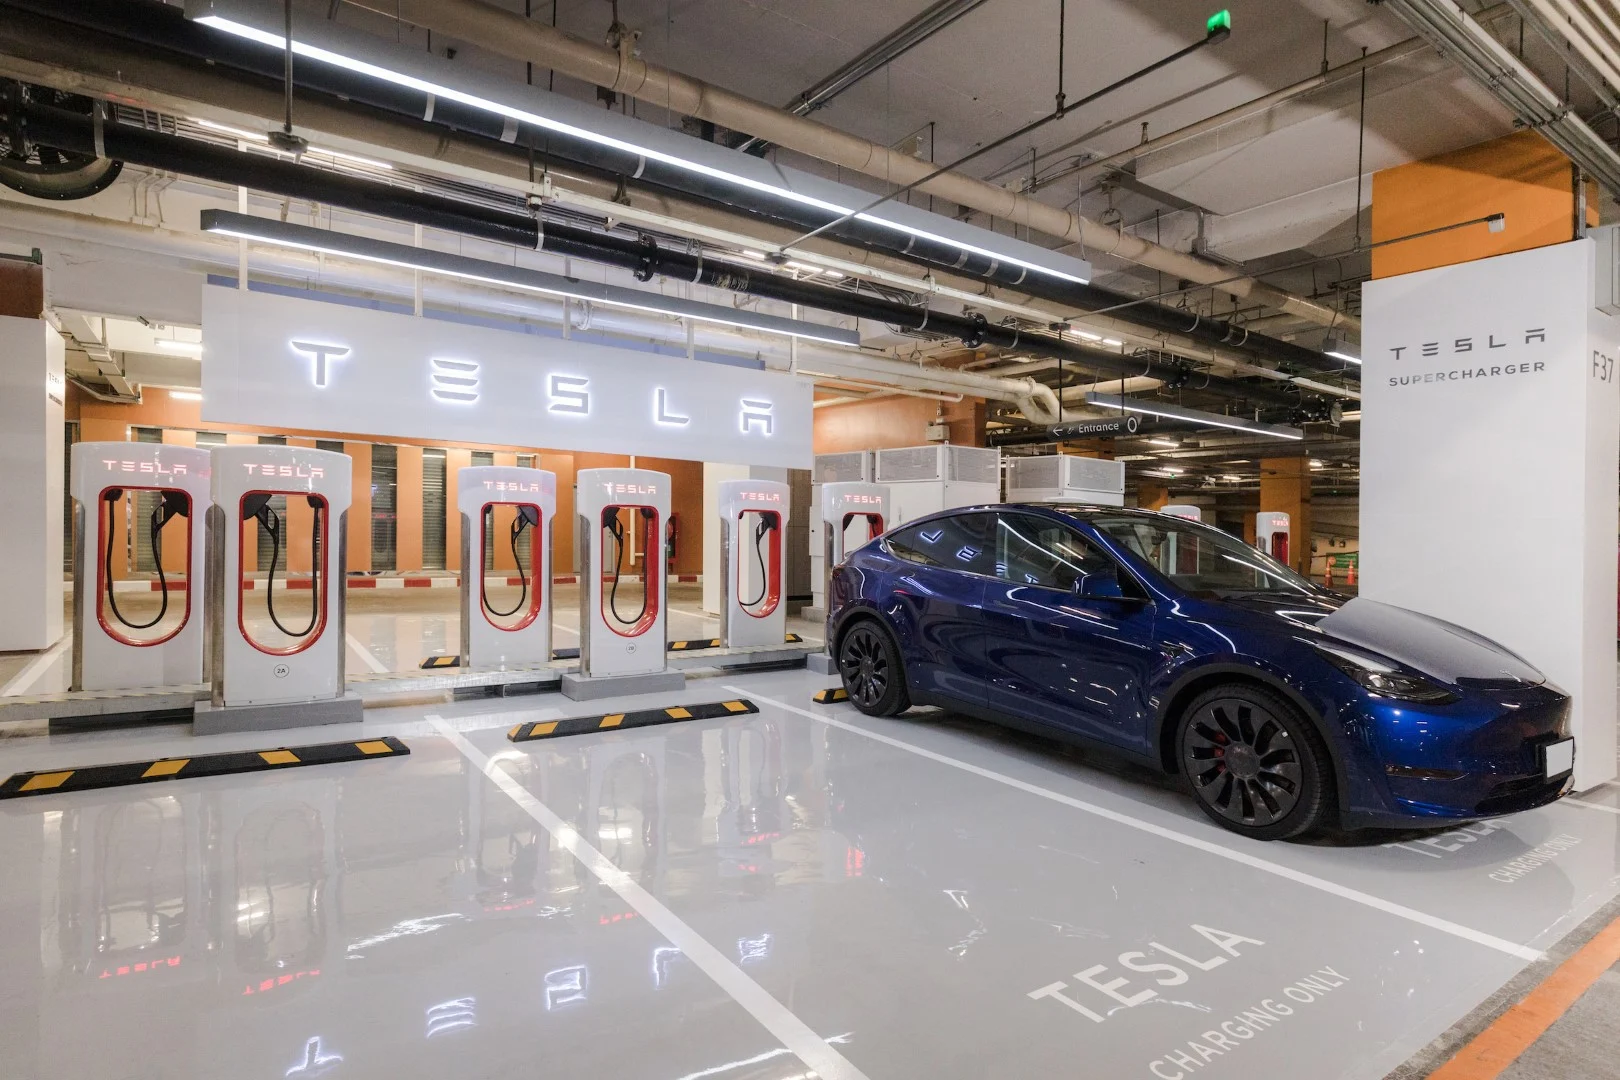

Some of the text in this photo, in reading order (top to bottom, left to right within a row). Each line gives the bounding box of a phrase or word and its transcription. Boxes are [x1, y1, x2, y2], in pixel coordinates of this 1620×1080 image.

[1389, 328, 1545, 360] TESLA
[1389, 361, 1545, 386] SUPERCHARGER
[1593, 350, 1614, 383] F37
[290, 340, 774, 435] TESLA
[1078, 422, 1120, 433] Entrance
[103, 459, 187, 474] TESLA
[243, 463, 324, 478] TESLA
[483, 481, 539, 492] TESLA
[603, 482, 656, 494] TESLA
[740, 492, 780, 501] TESLA
[844, 494, 882, 504] TESLA
[1488, 847, 1559, 883] CHARGING
[1026, 923, 1265, 1024] TESLA
[1149, 965, 1350, 1080] CHARGING ONLY
